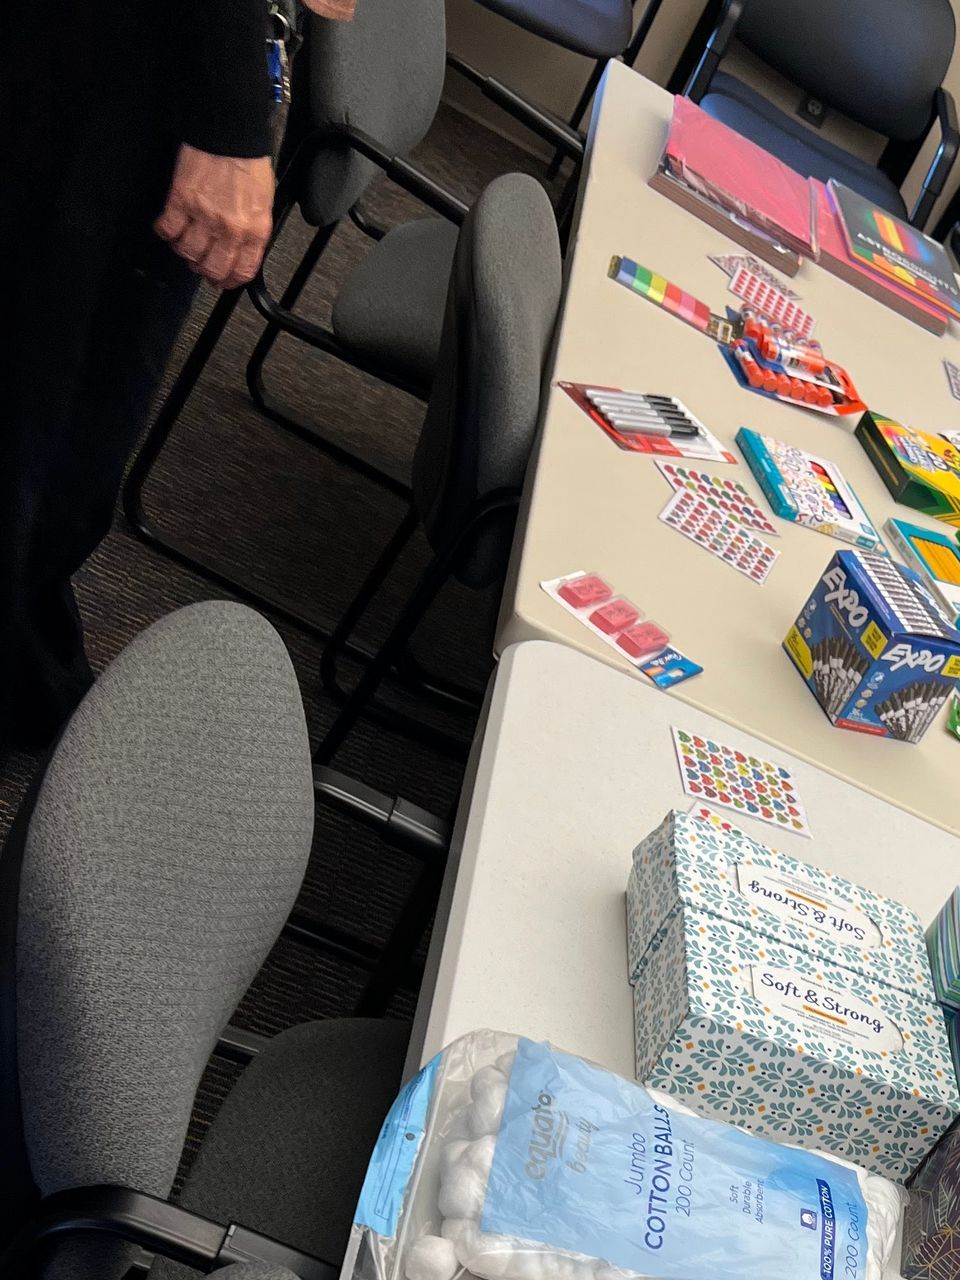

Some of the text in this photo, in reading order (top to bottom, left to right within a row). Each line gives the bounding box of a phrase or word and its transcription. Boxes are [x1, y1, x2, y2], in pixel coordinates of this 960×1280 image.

[822, 566, 869, 628] EXPO
[880, 643, 946, 673] EXPO
[748, 880, 812, 918] Strong
[812, 907, 829, 922] &
[830, 915, 867, 941] Soft
[760, 972, 801, 999] Soft
[804, 990, 823, 1006] &
[822, 996, 885, 1034] Strong
[623, 1133, 646, 1195] Jumbo
[645, 1104, 673, 1250] COTTON BALLS
[676, 1139, 696, 1217] 200 Count
[730, 1184, 739, 1204] Soft
[742, 1180, 753, 1214] Durable
[756, 1178, 766, 1224] Absorbent
[820, 1185, 833, 1275] 100% PURE COTTON
[845, 1201, 861, 1279] 200 Count
